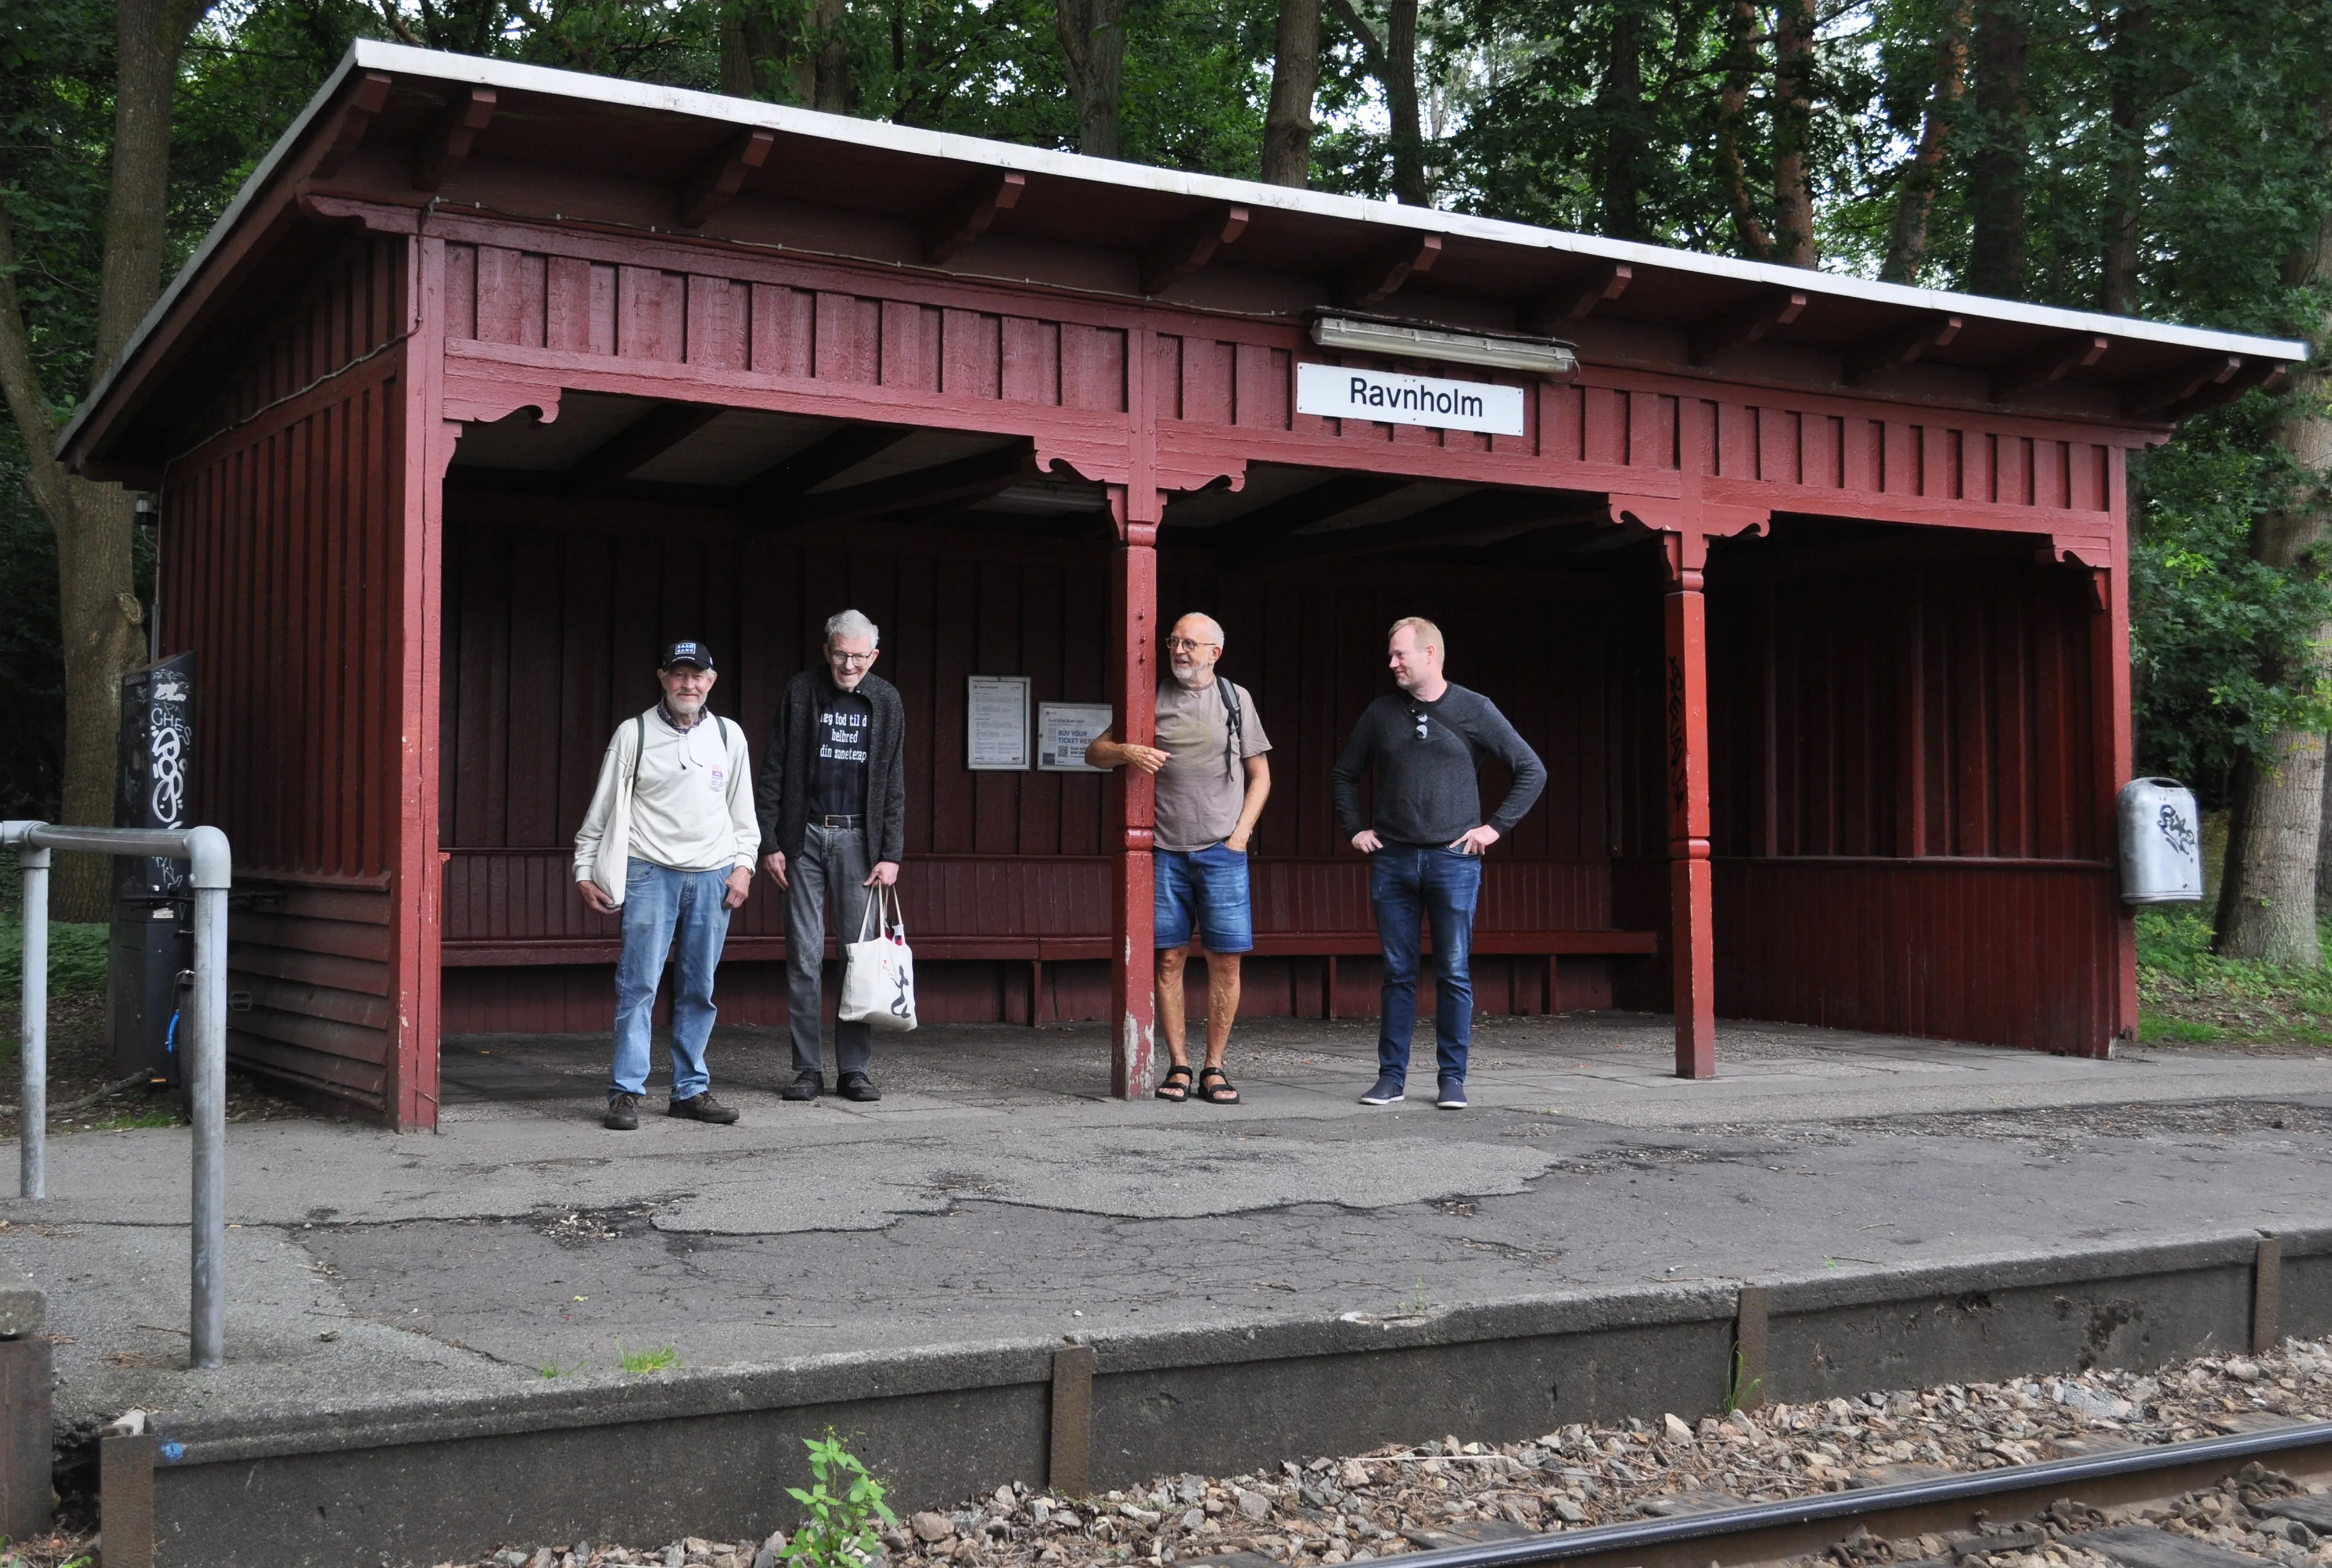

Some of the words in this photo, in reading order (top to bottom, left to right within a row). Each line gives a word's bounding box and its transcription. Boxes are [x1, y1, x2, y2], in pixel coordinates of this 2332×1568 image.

[1350, 377, 1482, 417] Ravnholm
[835, 712, 847, 726] fod
[849, 714, 860, 727] til
[831, 728, 858, 743] helbred
[820, 745, 832, 757] din
[834, 748, 867, 763] zoneterap
